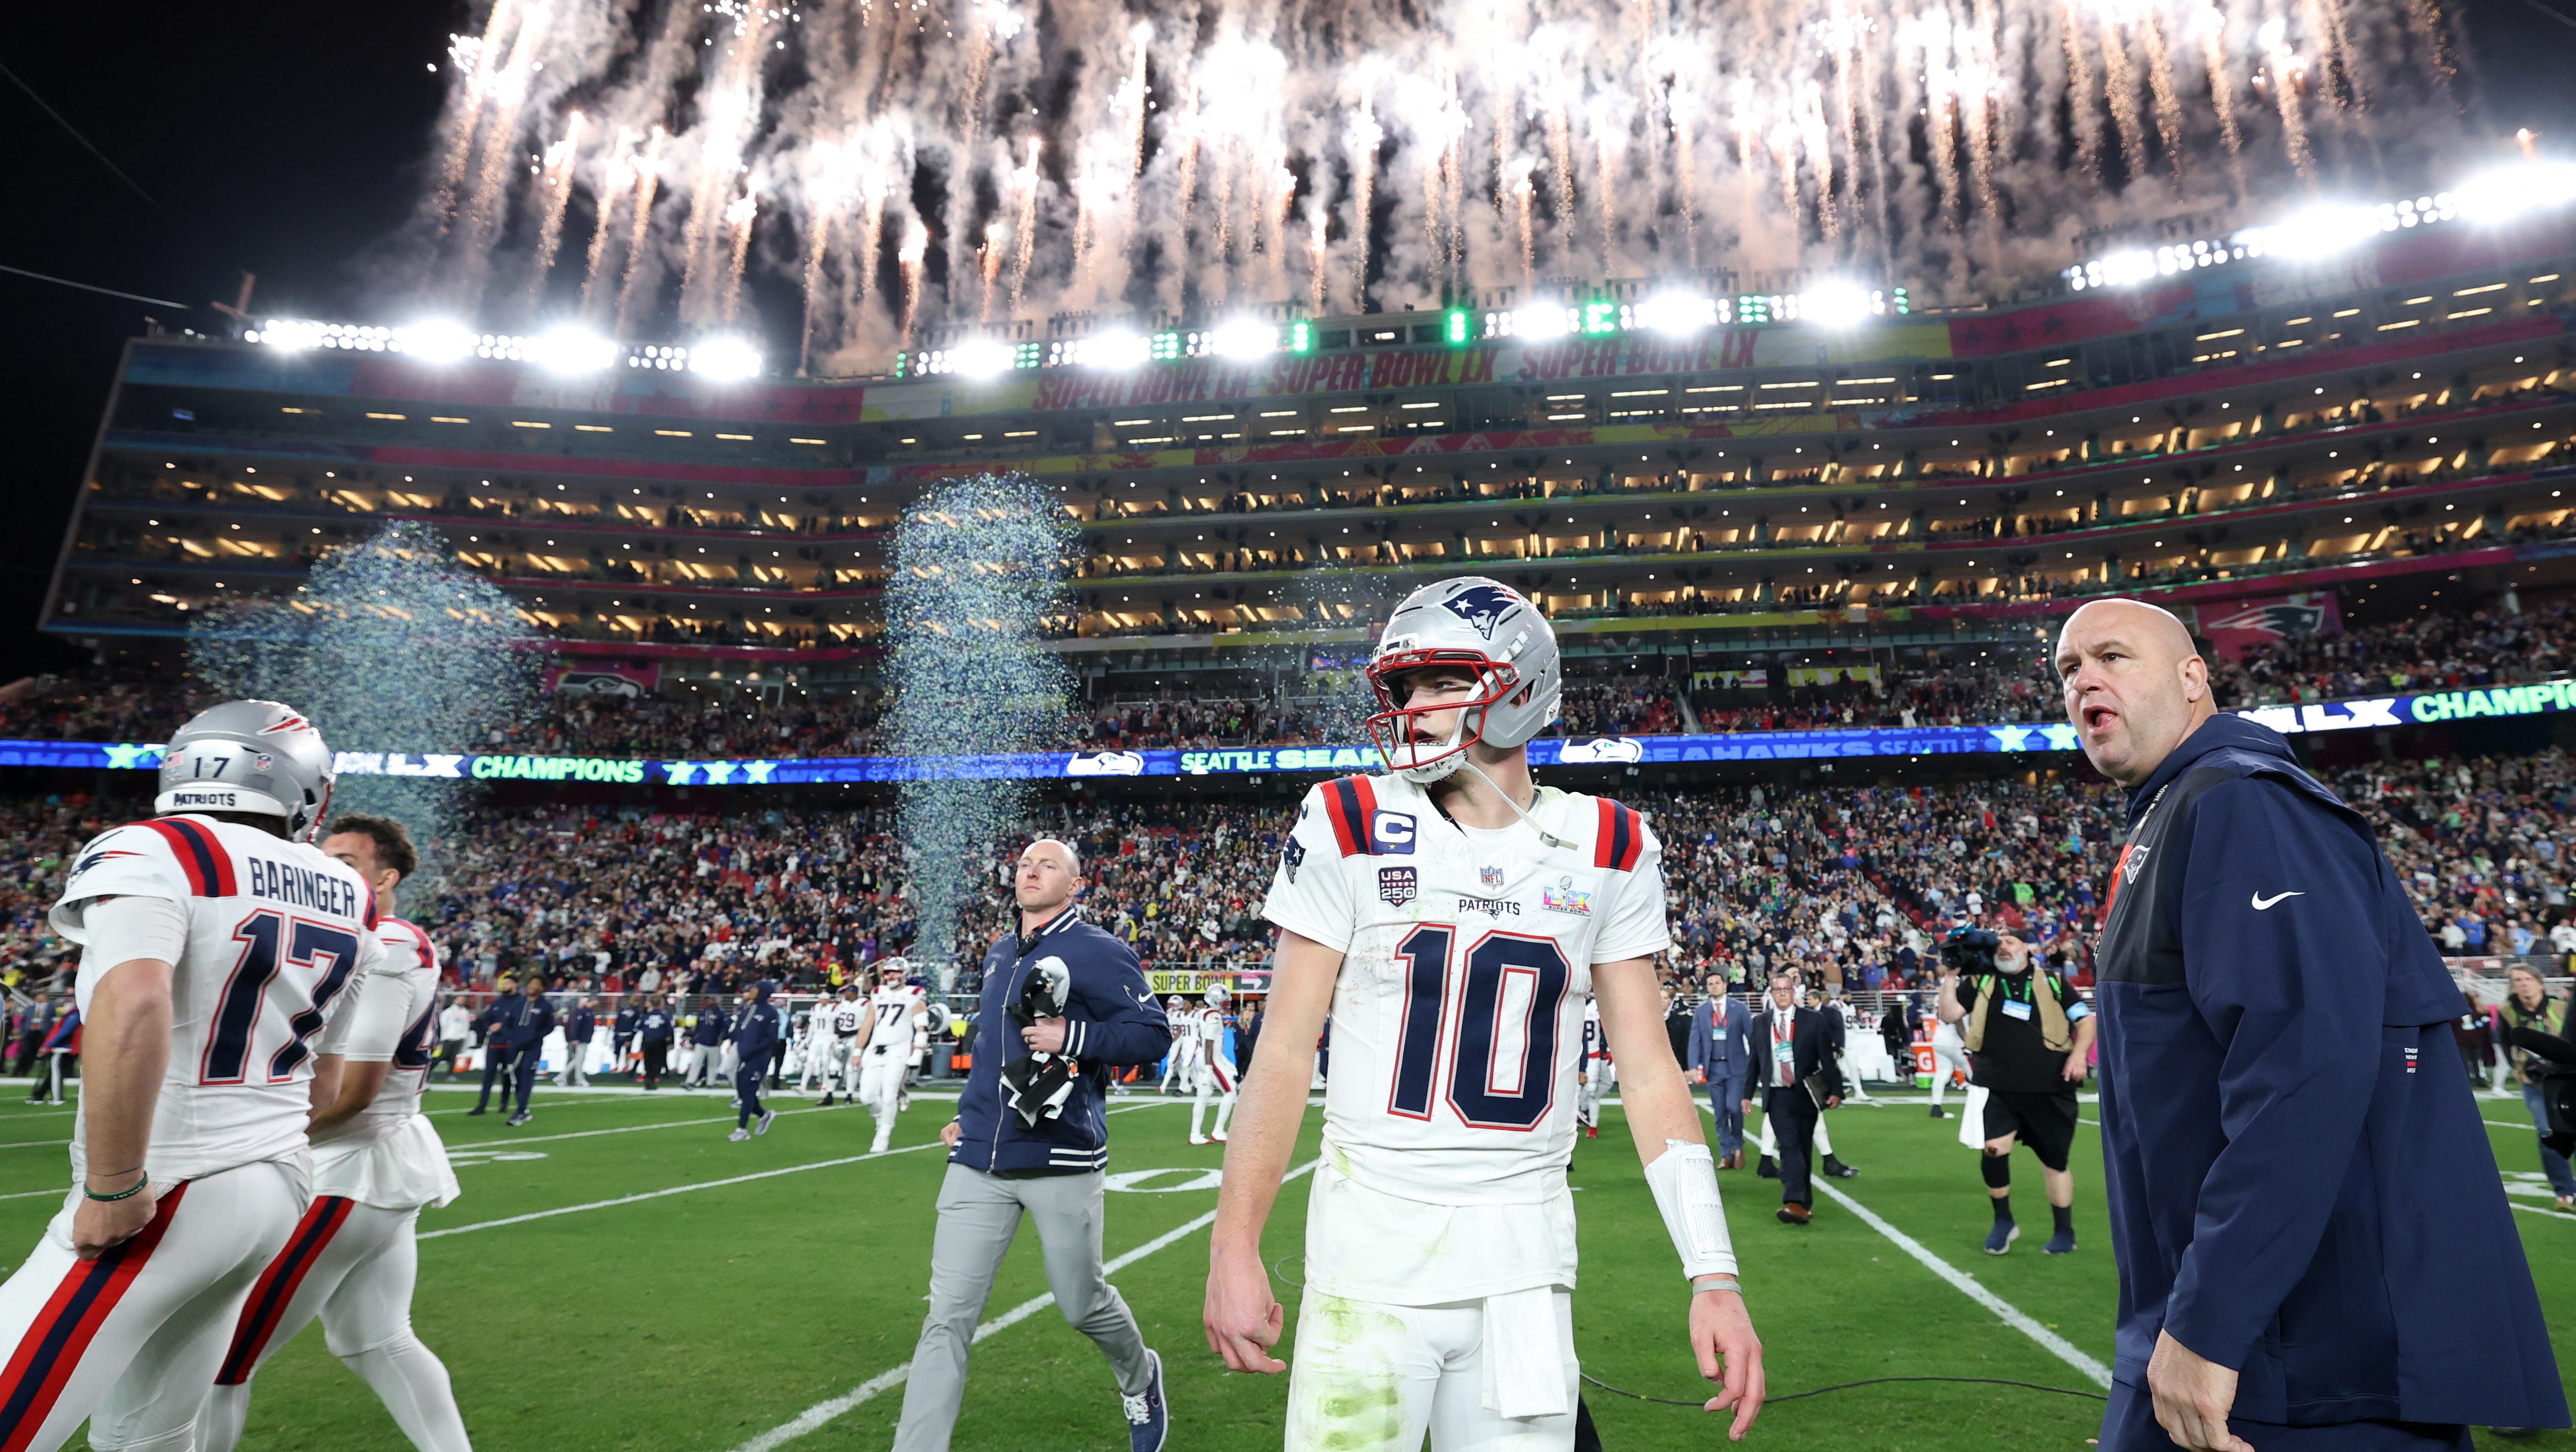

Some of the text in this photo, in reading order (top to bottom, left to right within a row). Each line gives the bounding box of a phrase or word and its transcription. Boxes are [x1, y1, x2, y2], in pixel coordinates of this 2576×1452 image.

[1518, 329, 1759, 380] SUPER BOWL LX
[1268, 345, 1499, 395] SUPER BOWL LX
[1034, 373, 1126, 410] SUPER
[1129, 365, 1207, 405] BOWL
[2304, 698, 2402, 732] LX
[194, 756, 231, 779] 17
[471, 755, 644, 782] CHAMPIONS
[1181, 751, 1271, 772] SEATTLE
[174, 793, 236, 807] PATRIOTS
[1374, 813, 1414, 844] C
[1380, 870, 1414, 881] USA
[1484, 875, 1501, 884] NFL
[249, 856, 356, 919] BARINGER
[1380, 887, 1416, 900] 250
[1458, 898, 1521, 916] PATRIOTS
[1154, 975, 1192, 991] SUPER
[199, 907, 361, 1086] 17
[876, 1003, 906, 1026] 77
[1387, 923, 1572, 1132] 10
[1917, 1051, 1933, 1072] G
